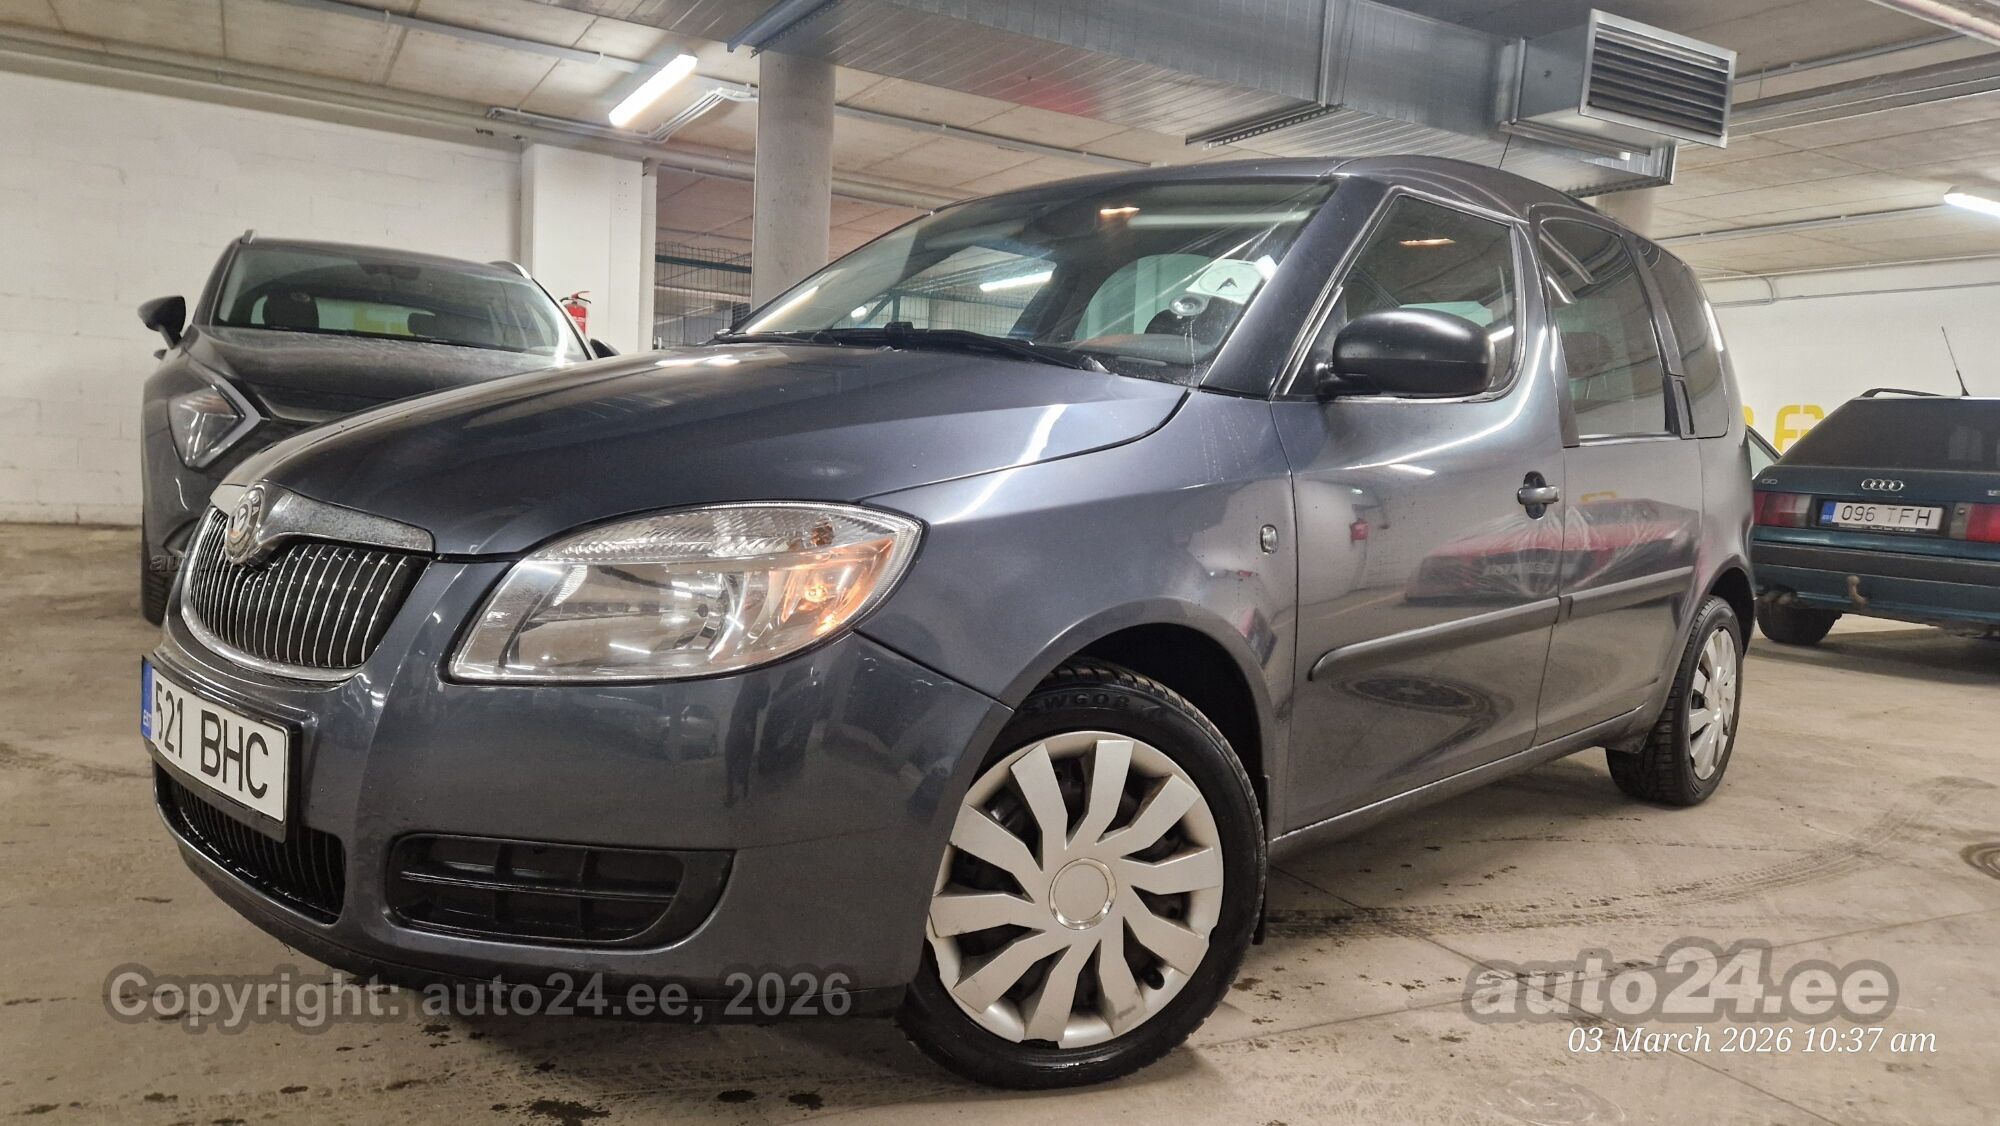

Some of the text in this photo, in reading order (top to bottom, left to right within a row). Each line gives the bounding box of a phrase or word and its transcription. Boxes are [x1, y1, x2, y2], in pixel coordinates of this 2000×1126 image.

[1841, 504, 1931, 527] 096 TFH
[155, 680, 269, 799] 521 BHC
